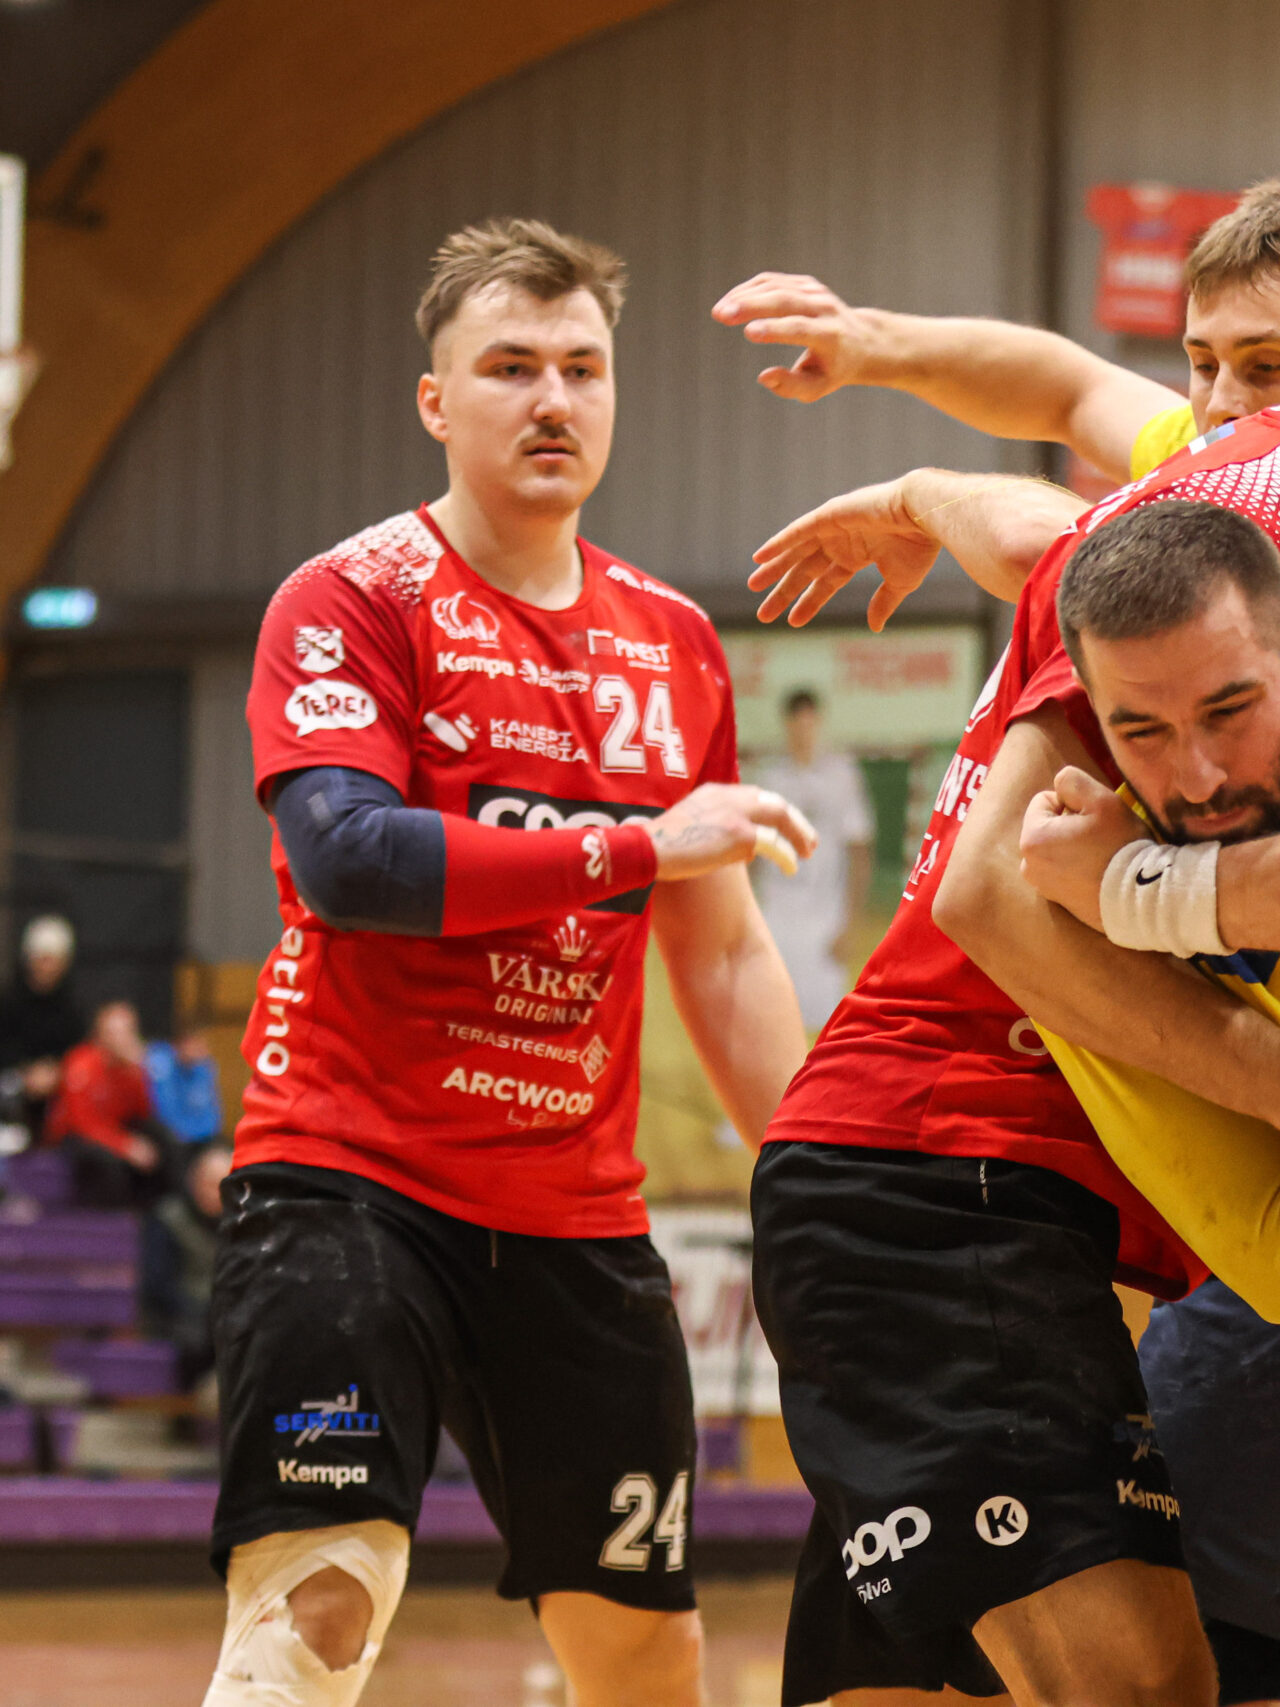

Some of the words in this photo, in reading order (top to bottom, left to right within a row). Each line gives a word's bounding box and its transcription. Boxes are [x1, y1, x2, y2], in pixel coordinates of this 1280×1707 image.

[437, 651, 515, 679] Kempa
[295, 693, 367, 718] TERE!
[489, 718, 574, 747] KANEPI
[593, 674, 689, 779] 24
[489, 733, 590, 764] ENERGIA
[256, 926, 305, 1076] acino
[446, 1022, 580, 1064] TERASTEENUS
[441, 1067, 594, 1116] ARCWOOD
[274, 1410, 380, 1433] SERVITI
[278, 1459, 369, 1490] Kempa
[599, 1471, 690, 1572] 24
